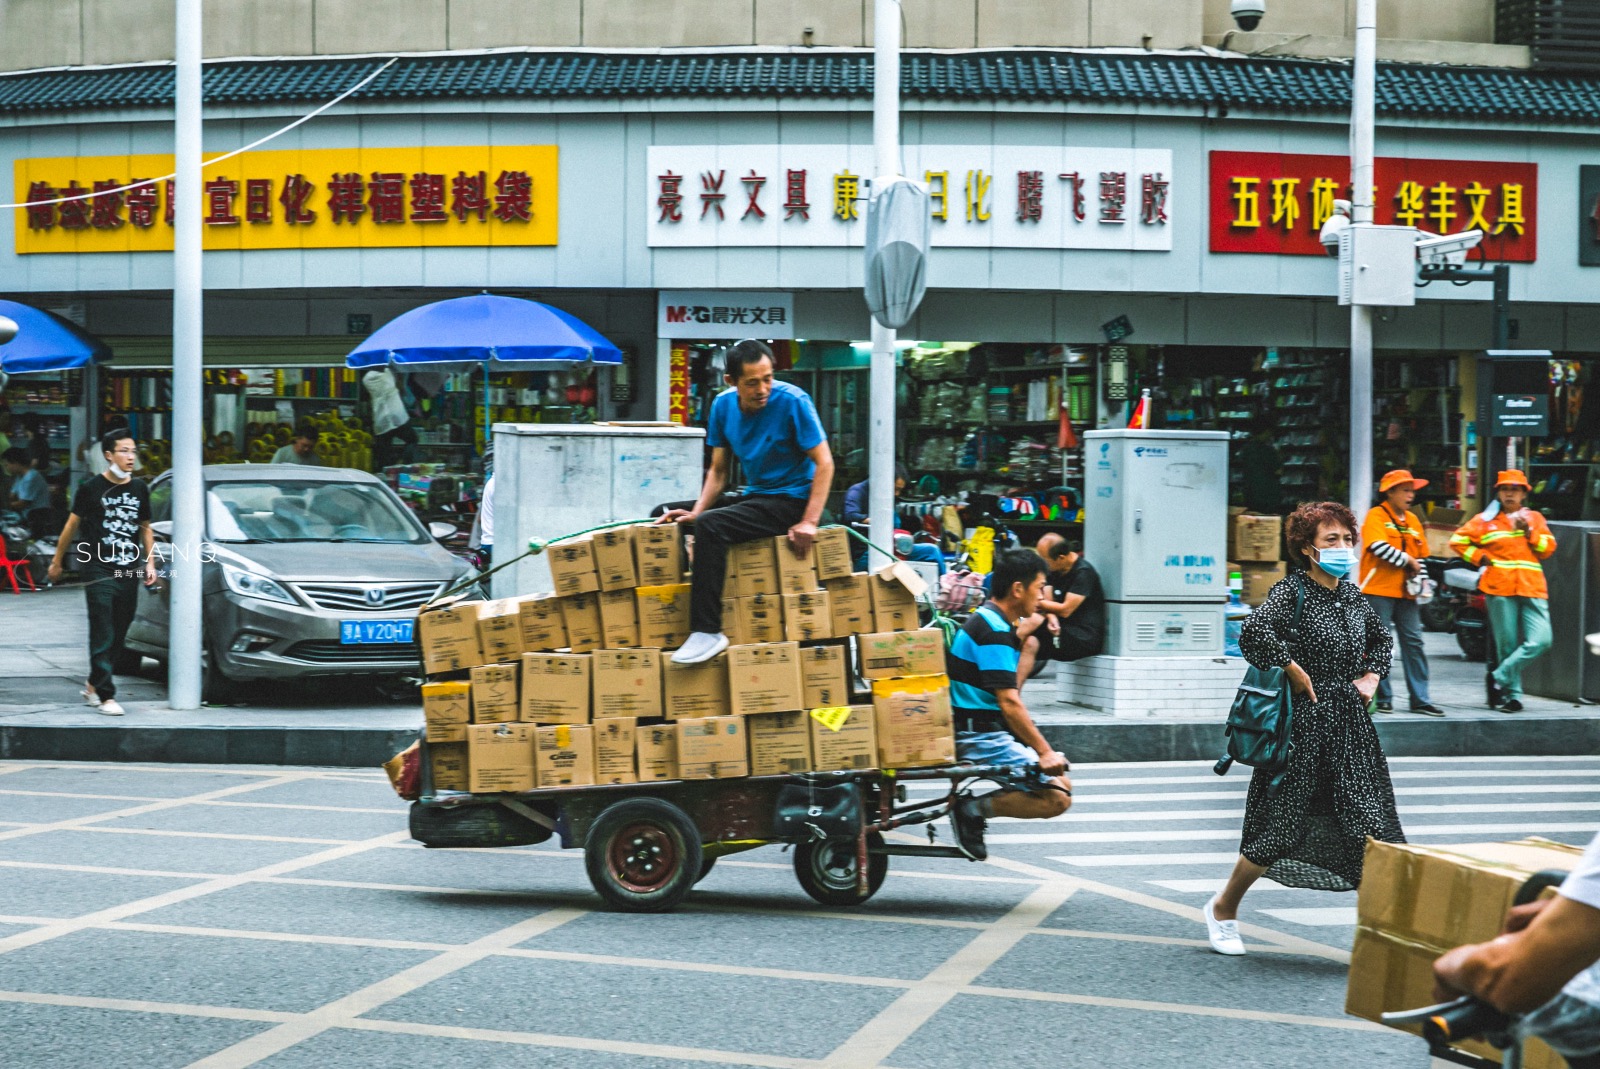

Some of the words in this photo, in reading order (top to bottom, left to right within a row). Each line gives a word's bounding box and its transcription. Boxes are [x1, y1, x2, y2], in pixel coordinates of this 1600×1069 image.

[164, 174, 318, 226] 宜日化
[327, 170, 533, 223] 祥福塑料袋
[657, 169, 811, 222] 亮兴文具
[833, 168, 992, 222] 康日化
[1016, 170, 1170, 224] 腾飞塑胶
[1231, 177, 1378, 231] 五环体
[1396, 181, 1526, 236] 华丰文具
[711, 306, 787, 325] 晨光文具
